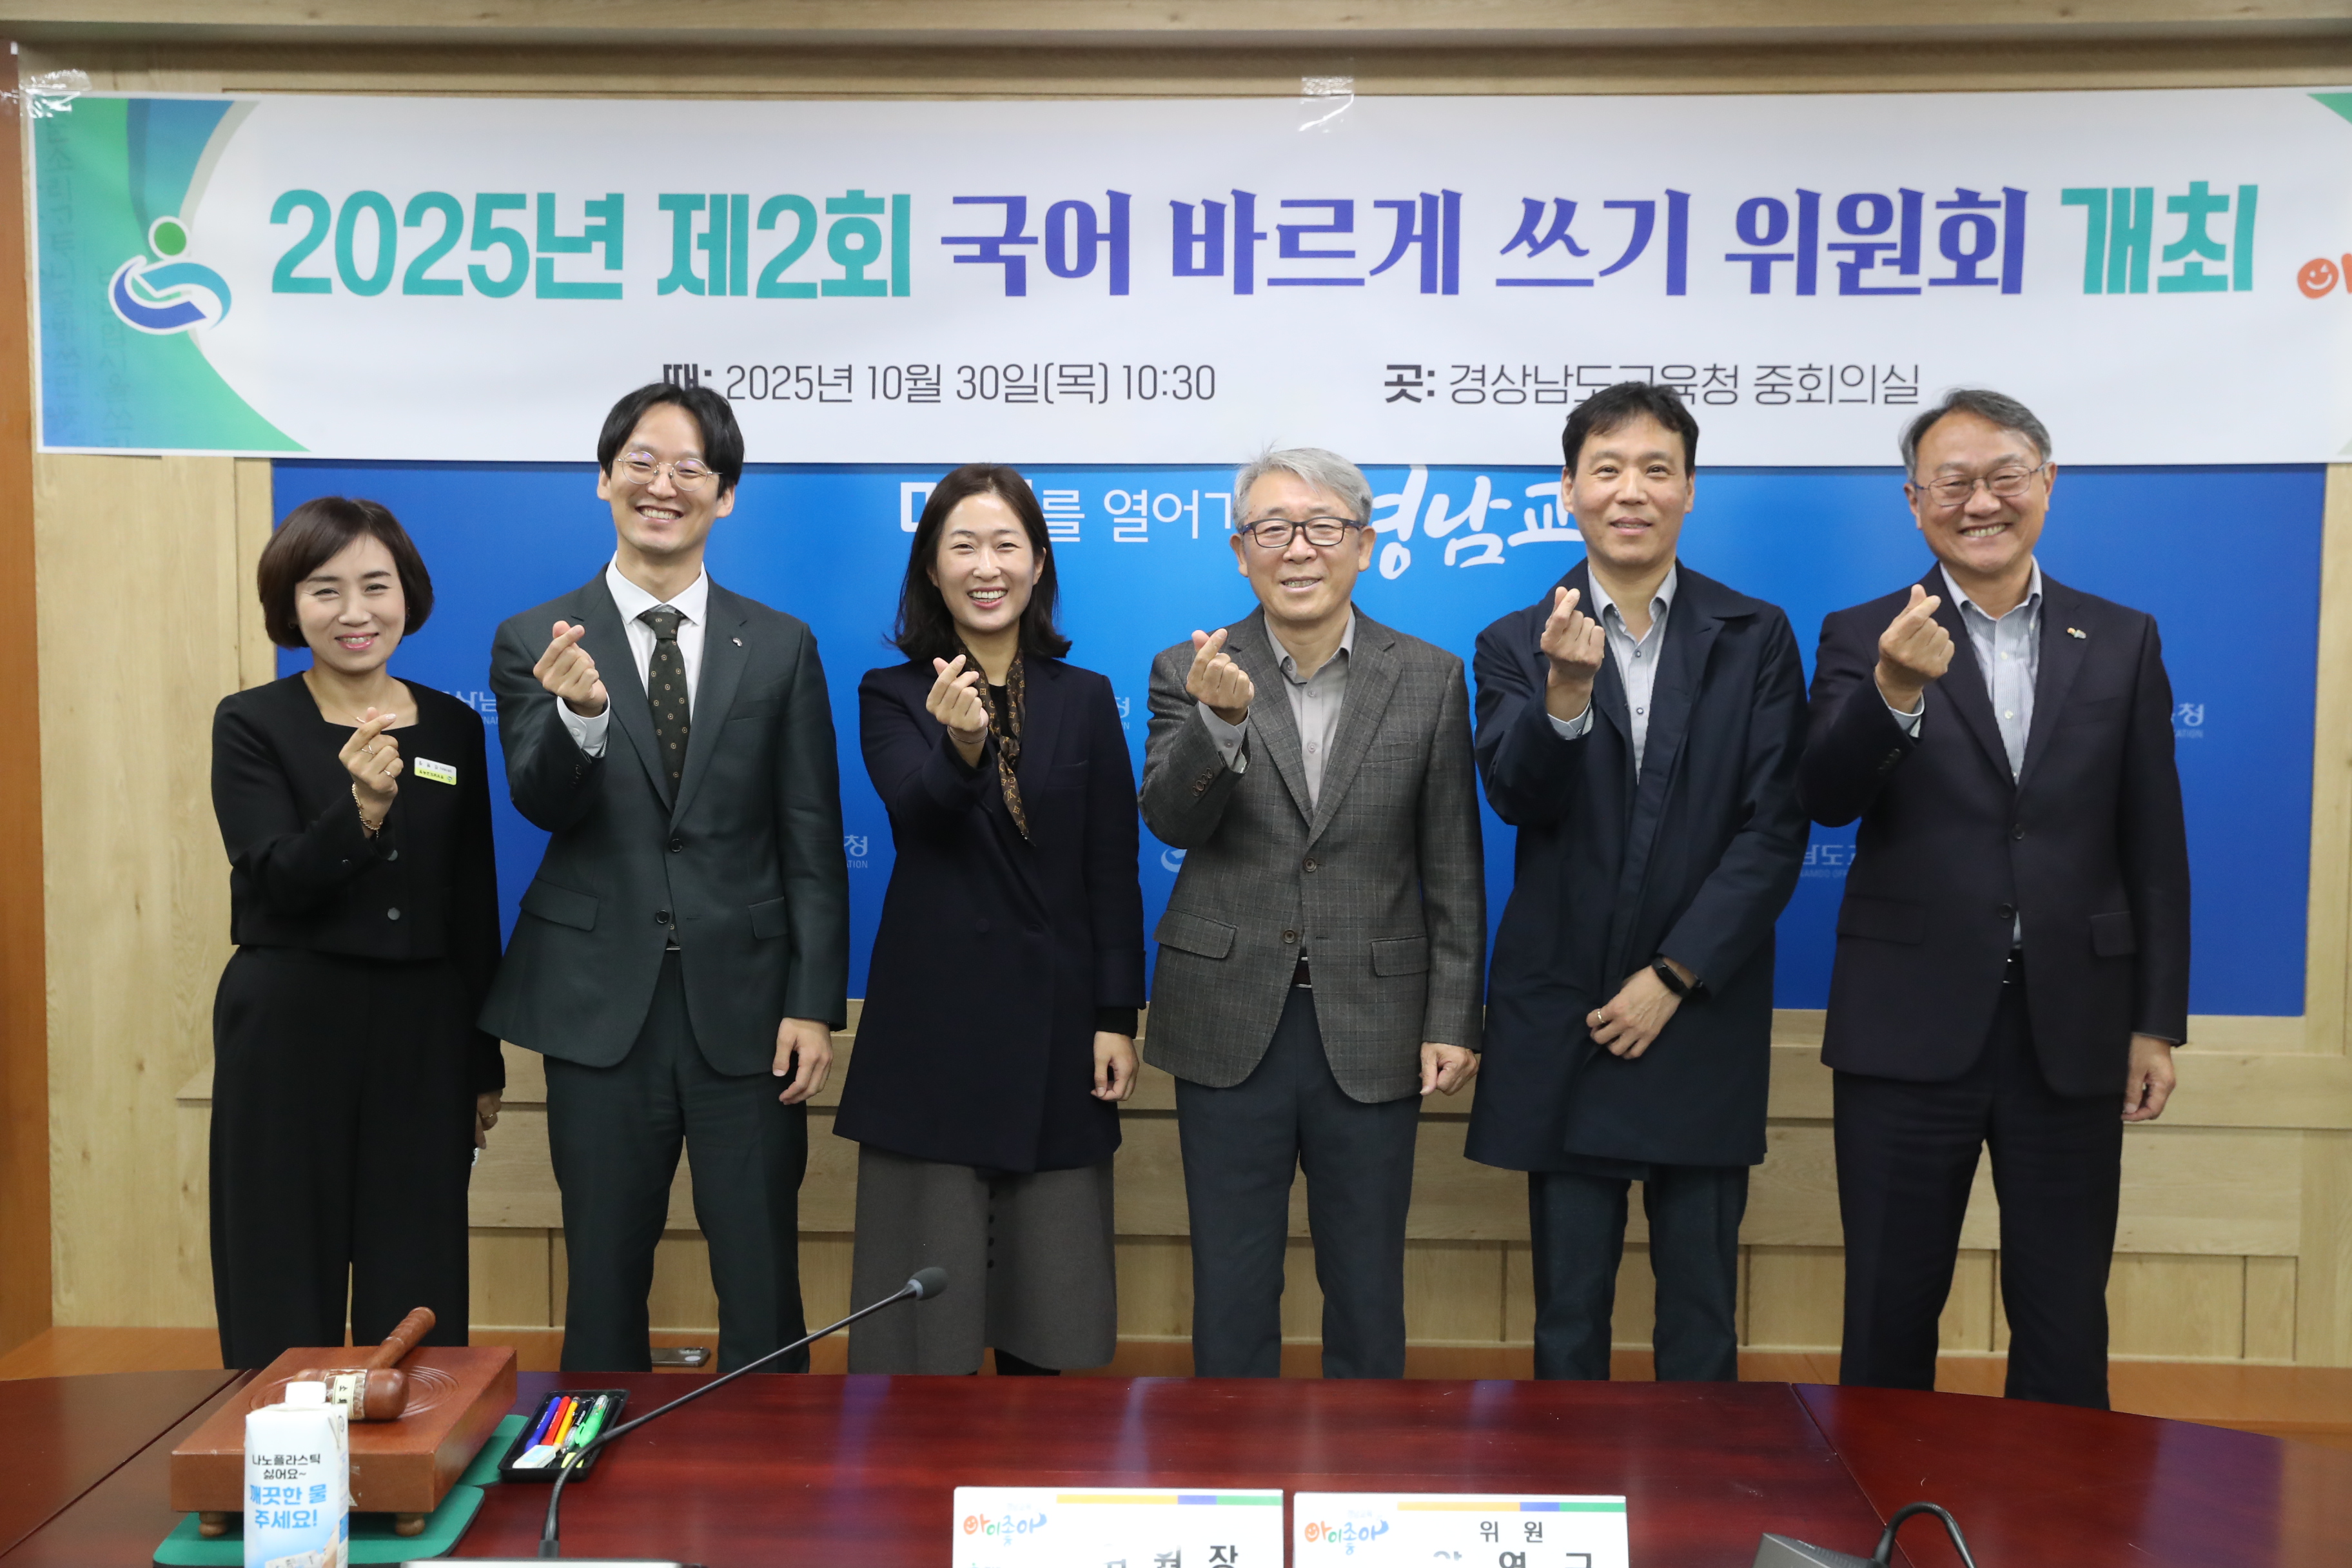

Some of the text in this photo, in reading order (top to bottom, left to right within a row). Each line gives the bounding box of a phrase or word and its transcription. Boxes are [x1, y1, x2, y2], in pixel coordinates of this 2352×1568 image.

[270, 188, 625, 300] 2025년
[657, 189, 912, 299] 제2회
[940, 189, 1133, 297] 국어
[1168, 188, 1463, 296] 바르게
[1495, 188, 1692, 297] 쓰기
[1724, 186, 2029, 297] 위원회
[2060, 180, 2259, 295] 개최
[726, 364, 853, 403] 2025년
[867, 364, 942, 404] 10월
[956, 362, 1109, 405] 30일(목)
[1122, 364, 1215, 401] 10:30
[1384, 364, 1436, 404] 곳:
[1753, 363, 1919, 406] 중회의실
[252, 1453, 321, 1465] 나노플라스틱
[309, 1483, 327, 1504] 물
[254, 1509, 318, 1529] 주세요!
